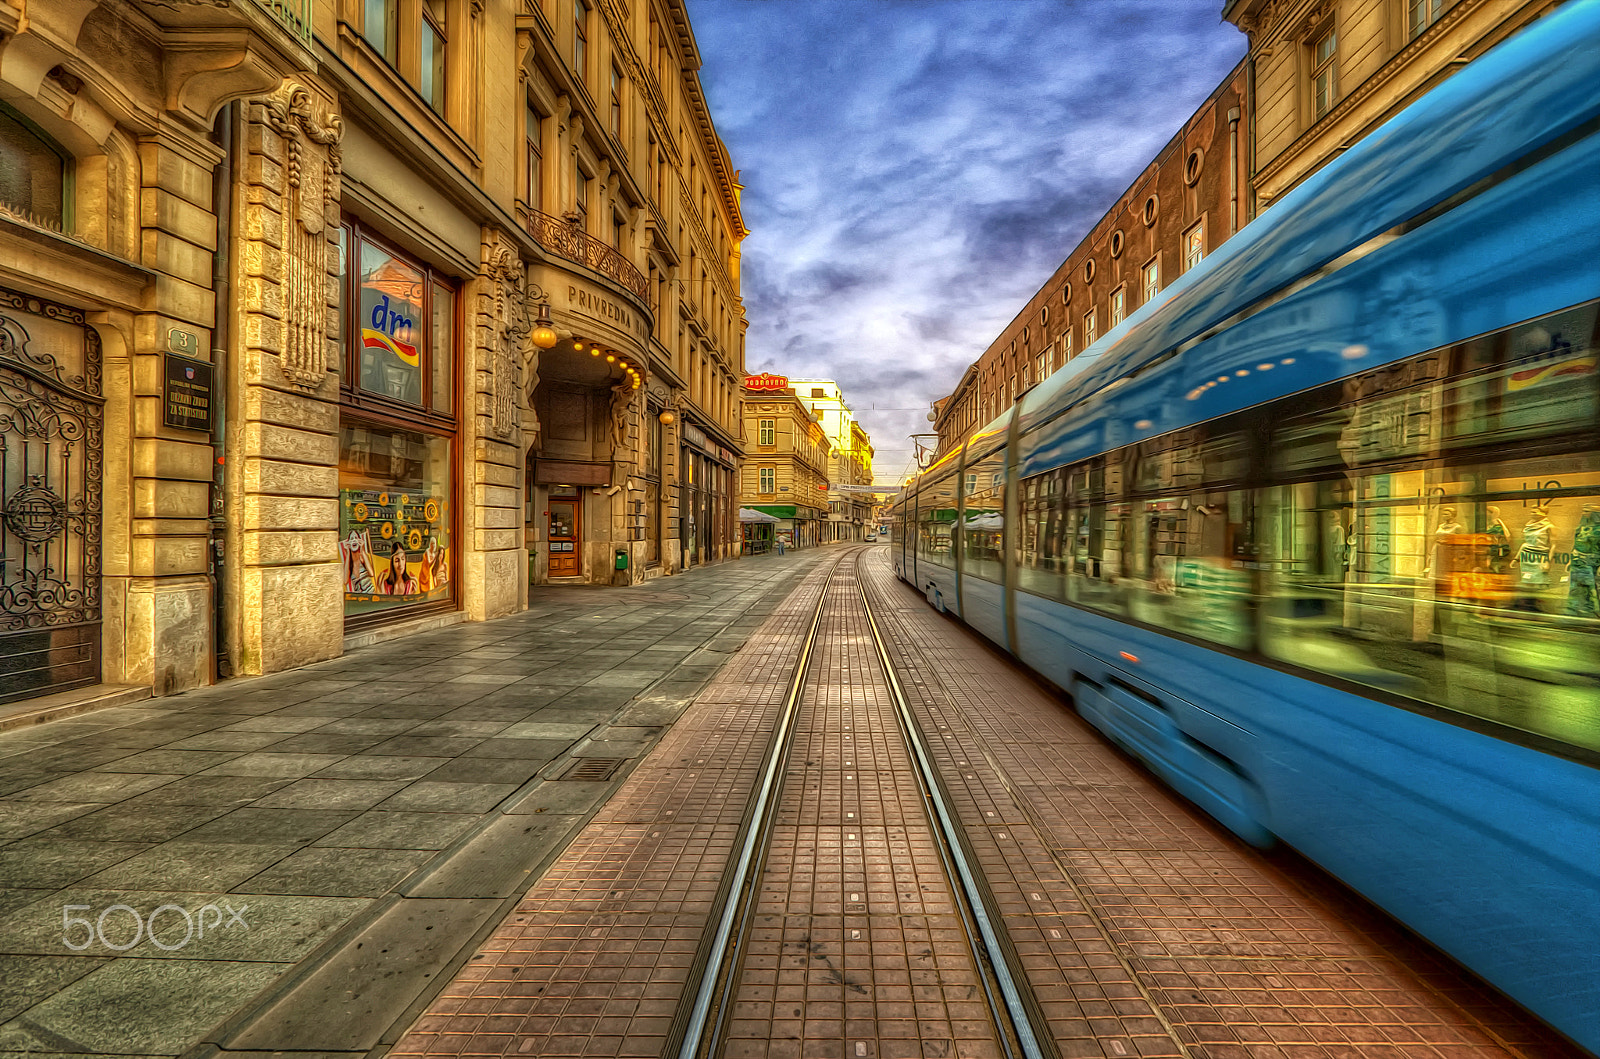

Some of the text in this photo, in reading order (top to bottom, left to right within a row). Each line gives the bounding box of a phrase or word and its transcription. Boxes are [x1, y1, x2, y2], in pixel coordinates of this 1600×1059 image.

[371, 294, 412, 343] dm
[568, 285, 631, 329] PRIVREDNA
[180, 332, 188, 347] 3
